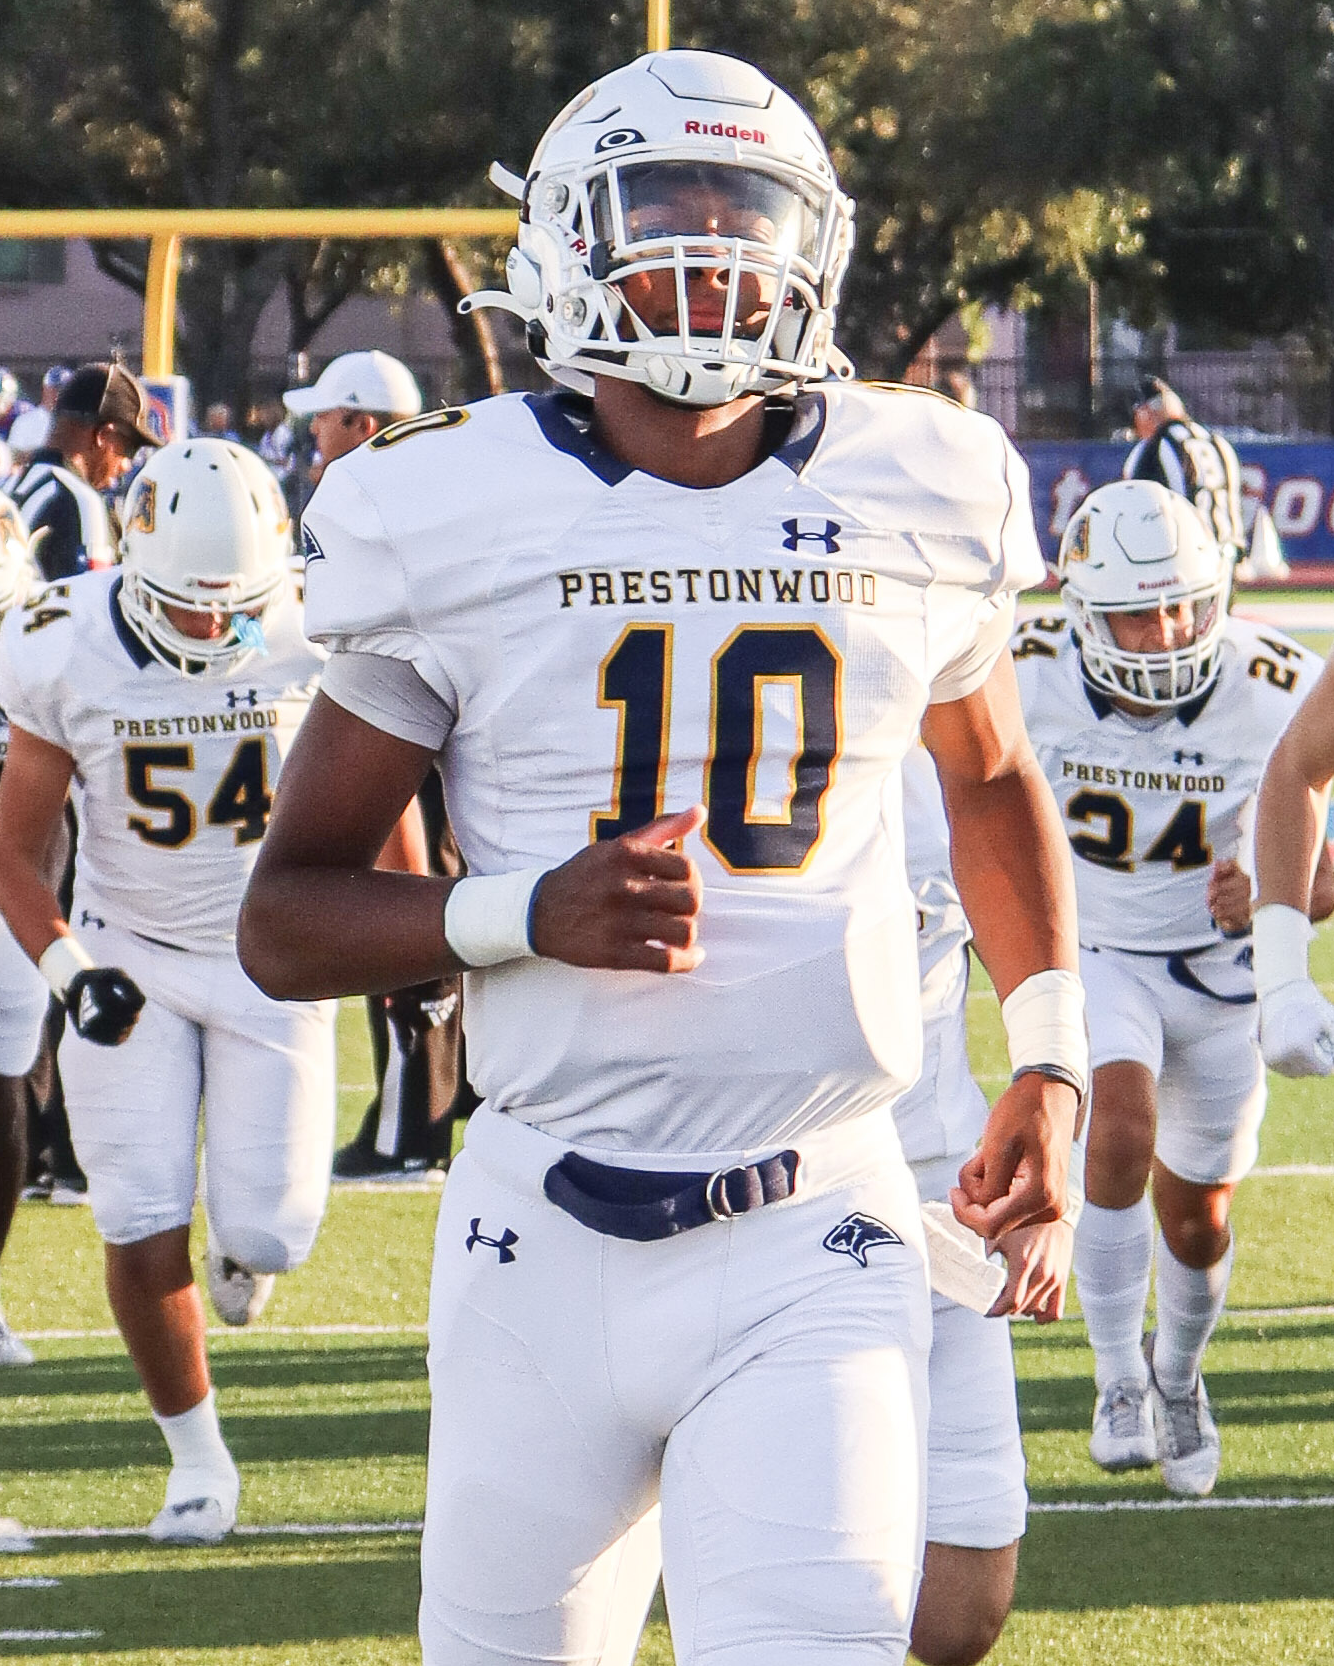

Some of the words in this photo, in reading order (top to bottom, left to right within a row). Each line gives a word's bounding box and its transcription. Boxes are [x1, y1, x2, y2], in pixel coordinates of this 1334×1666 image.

[684, 120, 766, 144] Riddell
[559, 569, 877, 609] PRESTONWOOD
[114, 709, 278, 737] PRESTONWOOD
[588, 621, 845, 878] 10
[122, 735, 274, 850] 54
[1063, 760, 1226, 792] PRESTONWOOD
[1066, 786, 1214, 873] 24
